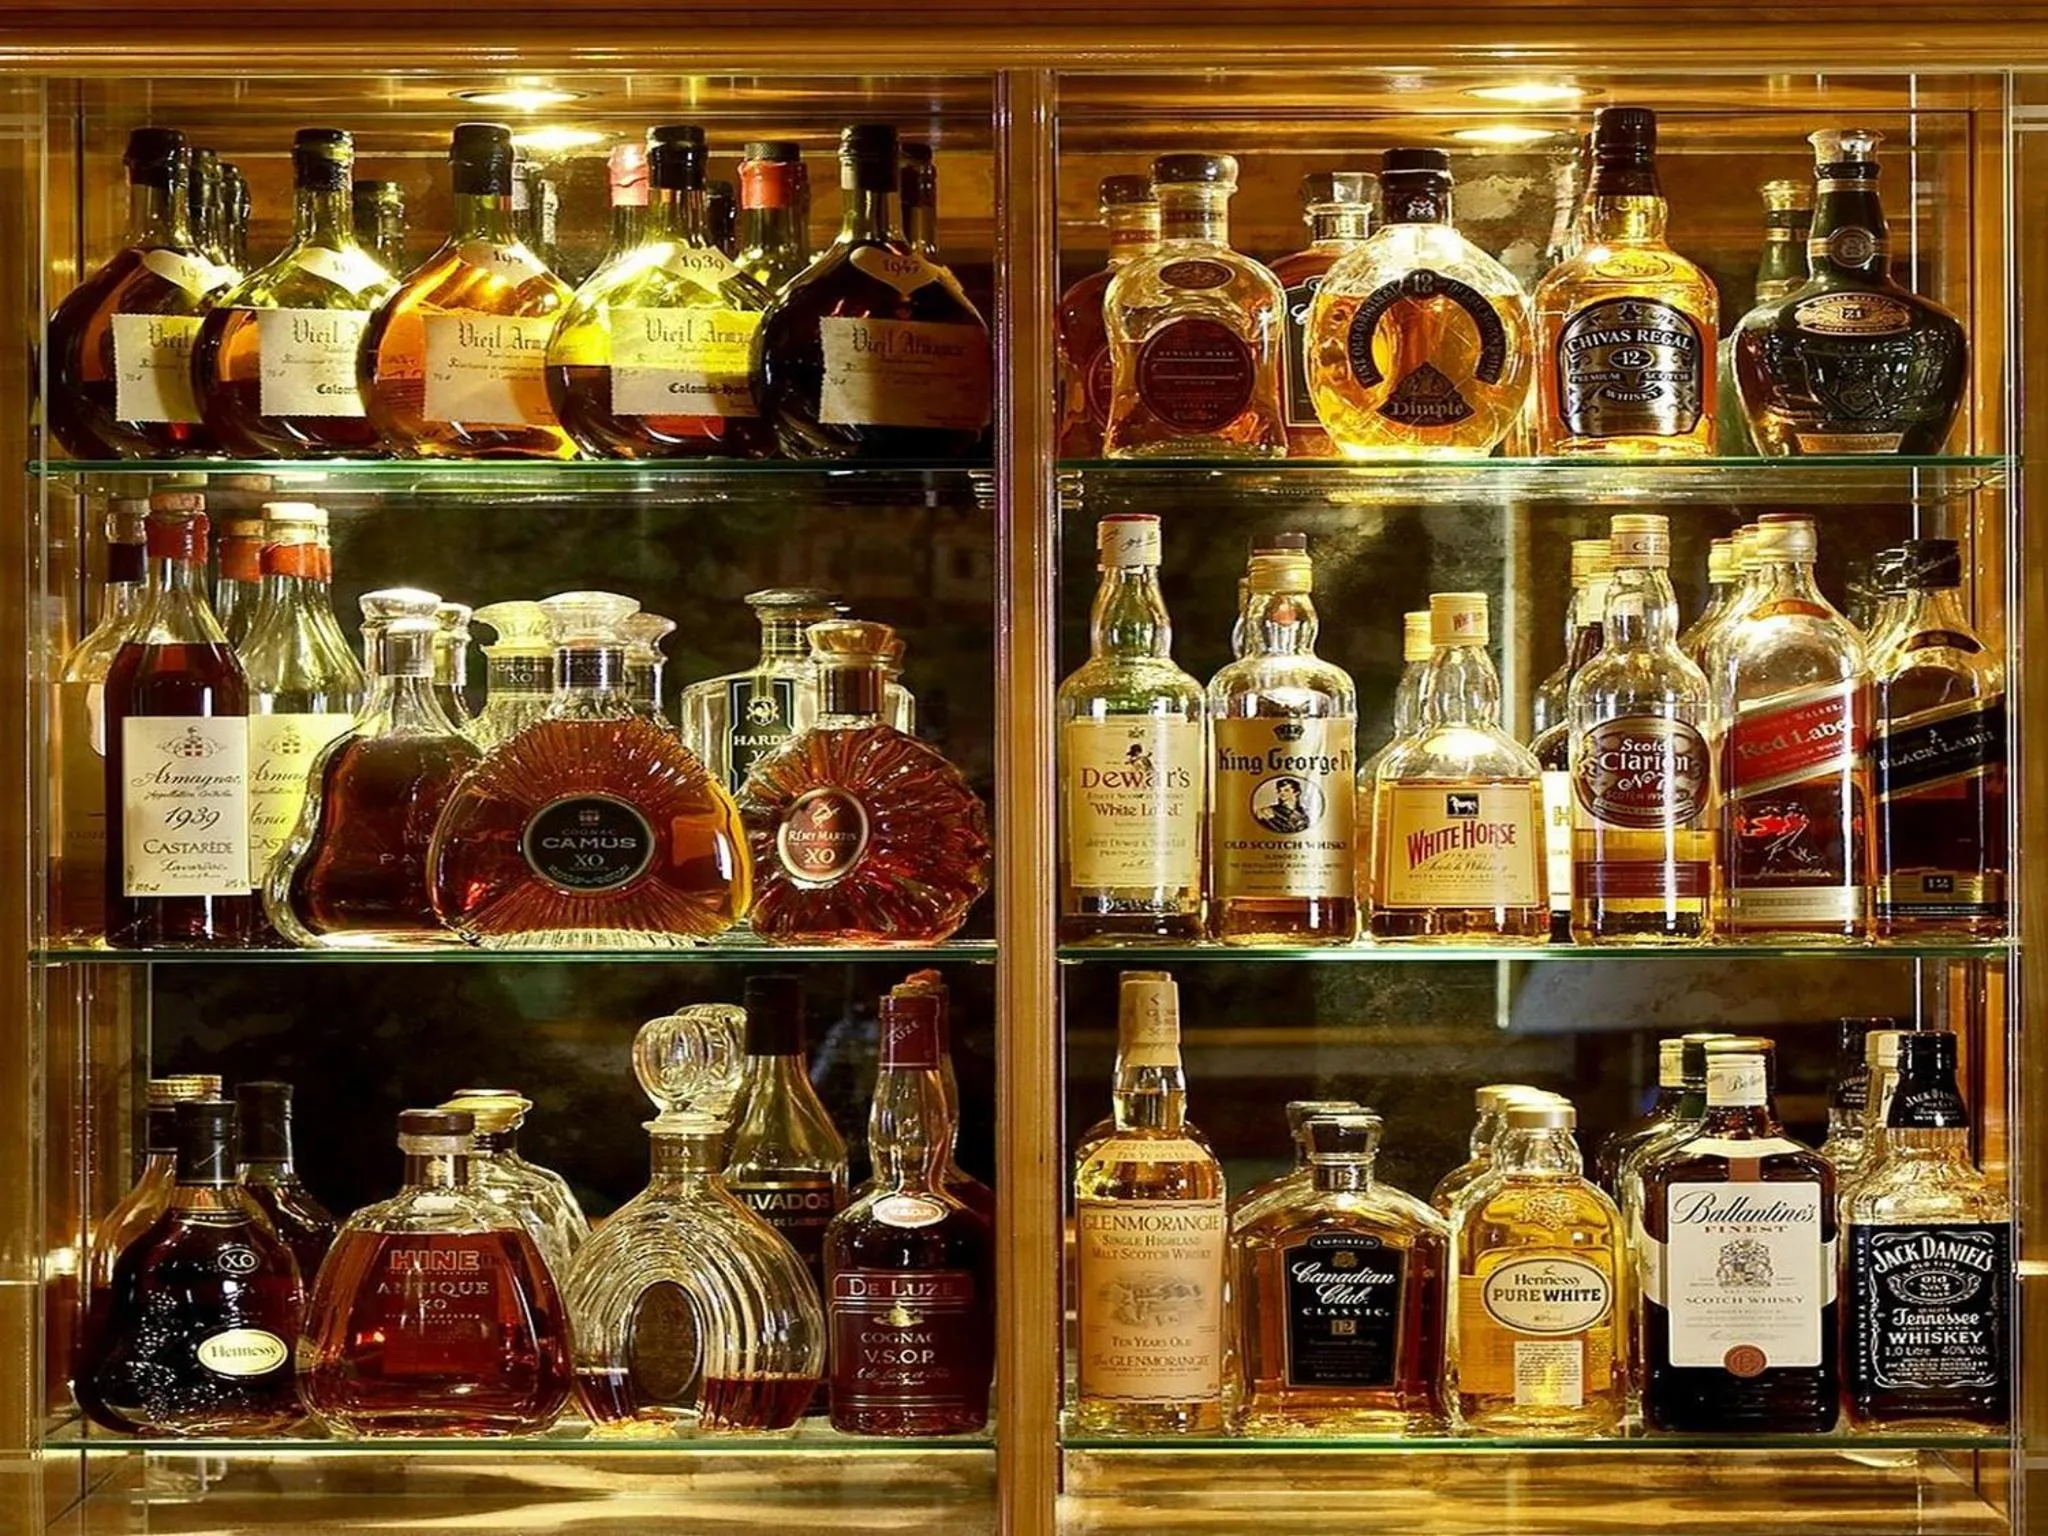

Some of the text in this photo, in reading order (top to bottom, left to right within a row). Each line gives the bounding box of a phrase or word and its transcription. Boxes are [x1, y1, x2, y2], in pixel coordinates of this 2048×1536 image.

[681, 254, 726, 273] 1939
[457, 319, 501, 349] Vieil
[1567, 328, 1692, 354] CHIVAS REGAL
[1621, 350, 1642, 366] 12
[1391, 401, 1465, 418] Dimple
[509, 672, 533, 683] XO
[1737, 731, 1789, 760] Red
[1218, 747, 1264, 776] King
[1267, 747, 1340, 776] George
[1879, 746, 1939, 770] BLACK
[164, 806, 221, 831] 1939
[541, 836, 637, 850] CAMUS
[1248, 840, 1303, 850] SCOTCH
[1407, 820, 1517, 871] WHITE HORSE
[574, 853, 605, 867] XO
[804, 848, 835, 864] XO
[1670, 1190, 1816, 1224] Ballantine's
[1083, 1214, 1220, 1232] GLENMORANGIE
[224, 1253, 256, 1268] XO
[390, 1250, 480, 1271] HINE
[1871, 1236, 1995, 1273] JACK DANIEL'S
[1291, 1261, 1397, 1285] Canadian
[1514, 1273, 1583, 1289] Hennessy
[1920, 1275, 1948, 1284] Old
[848, 1278, 955, 1297] DE LUZE
[1494, 1288, 1602, 1302] PURE WHITE
[1891, 1307, 1981, 1326] Tennessee
[1887, 1331, 1984, 1345] WHISKEY
[211, 1345, 278, 1358] Hennessy
